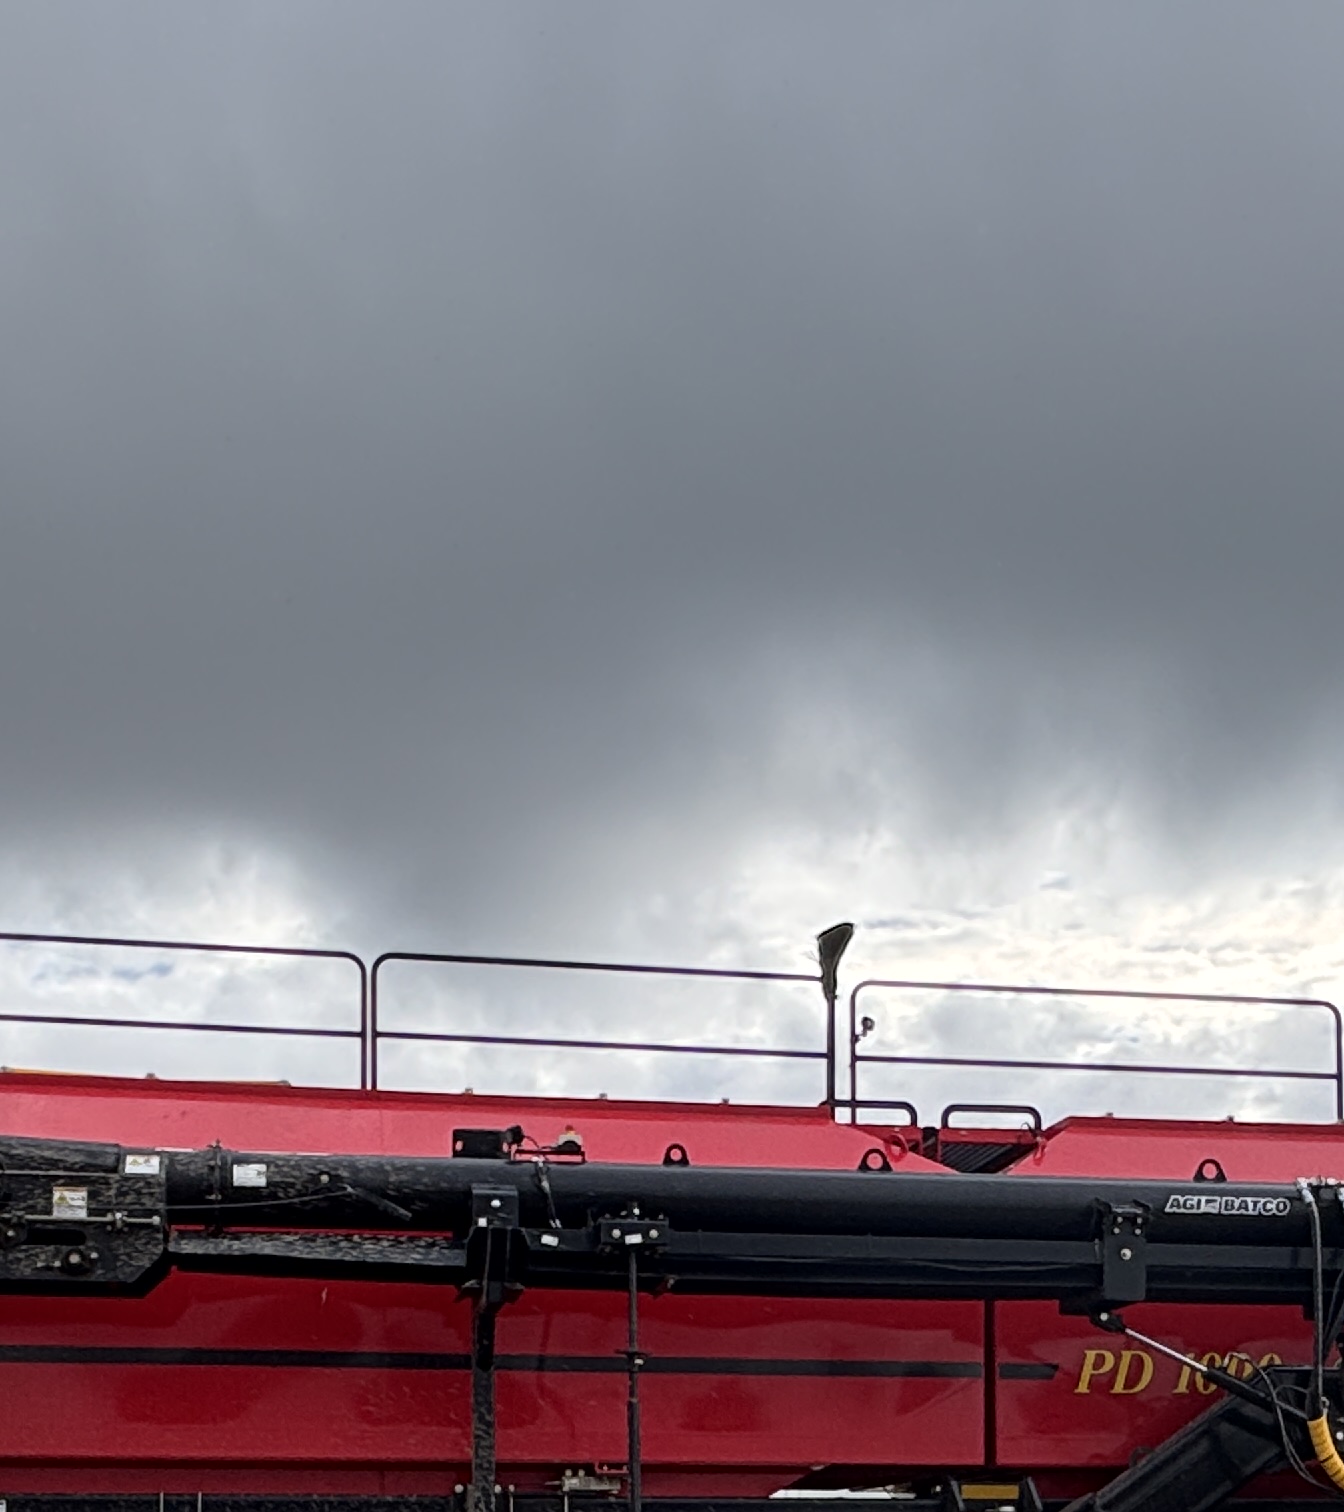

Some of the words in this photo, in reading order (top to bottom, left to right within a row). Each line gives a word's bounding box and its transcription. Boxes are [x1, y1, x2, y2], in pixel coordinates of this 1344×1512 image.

[1166, 1196, 1202, 1213] AGI
[1221, 1197, 1291, 1215] BATCO
[1073, 1349, 1155, 1395] PD
